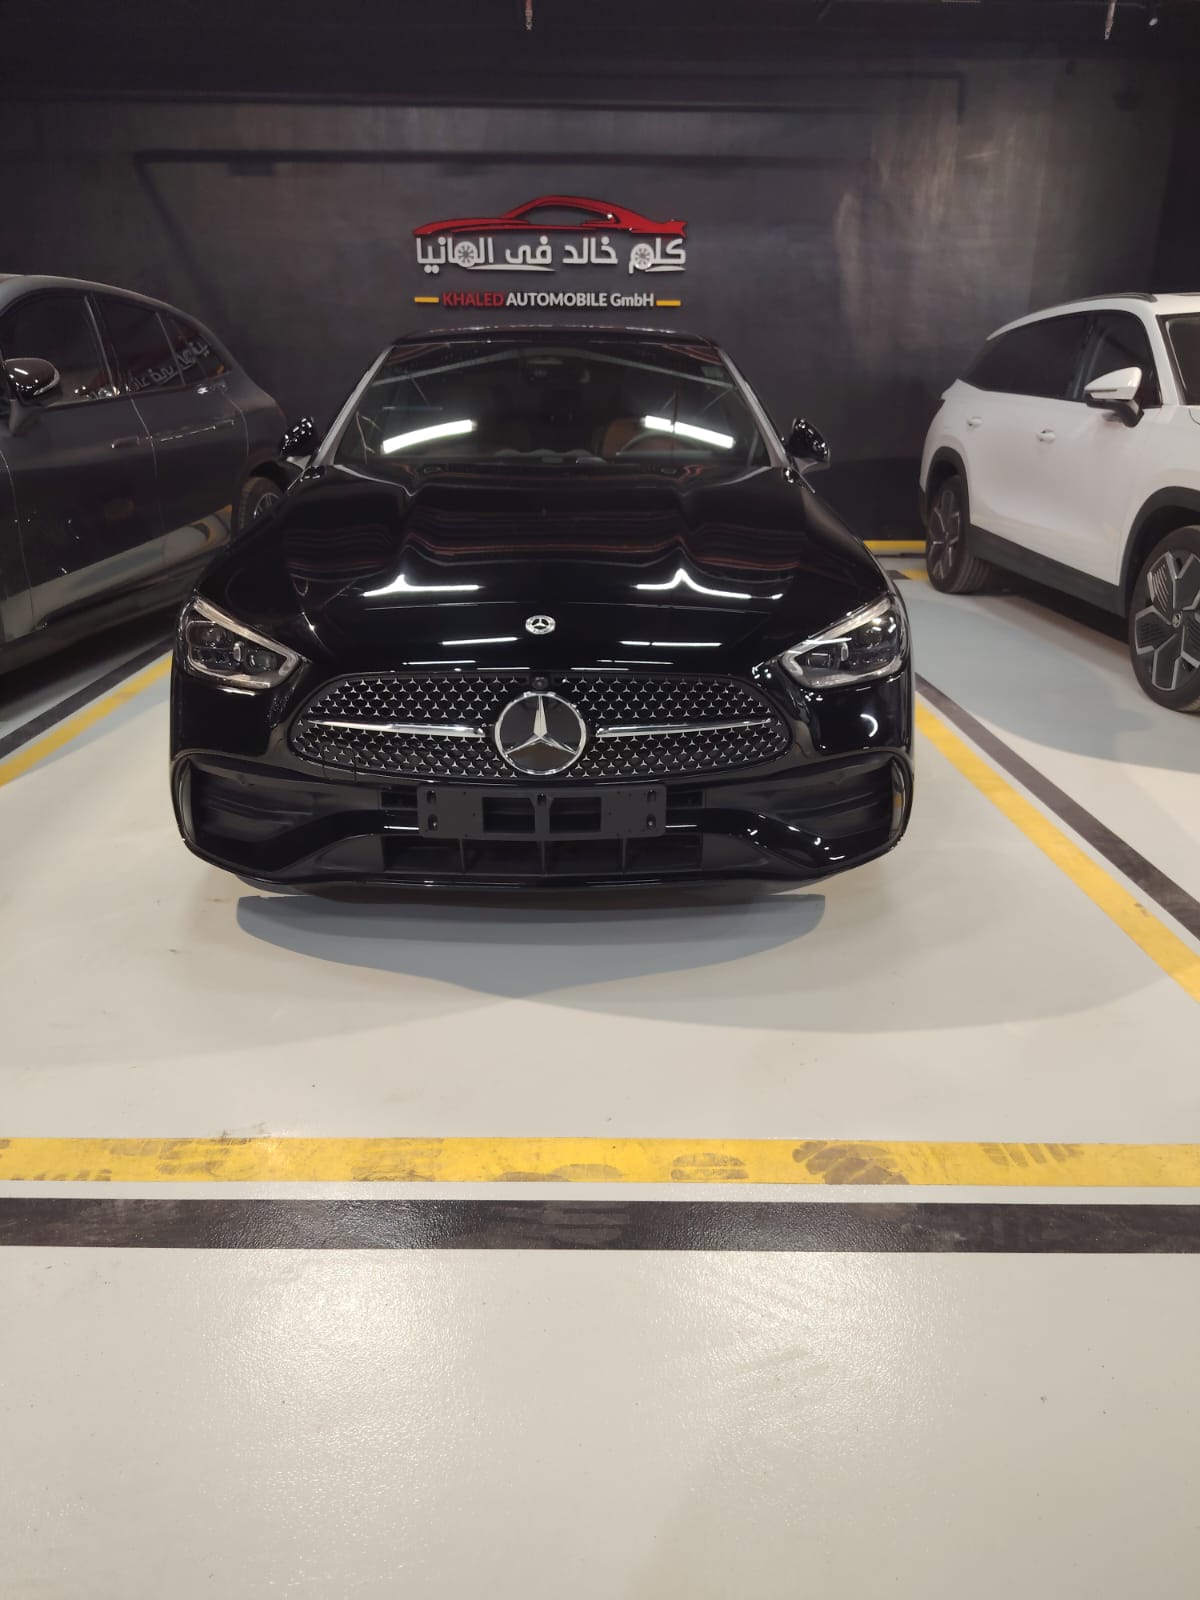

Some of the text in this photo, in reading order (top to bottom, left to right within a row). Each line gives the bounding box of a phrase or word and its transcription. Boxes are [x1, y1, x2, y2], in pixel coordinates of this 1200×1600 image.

[416, 236, 495, 274] المانيا
[562, 235, 619, 265] خالد
[442, 292, 655, 307] KHALED AUTOMOBILE GmbH
